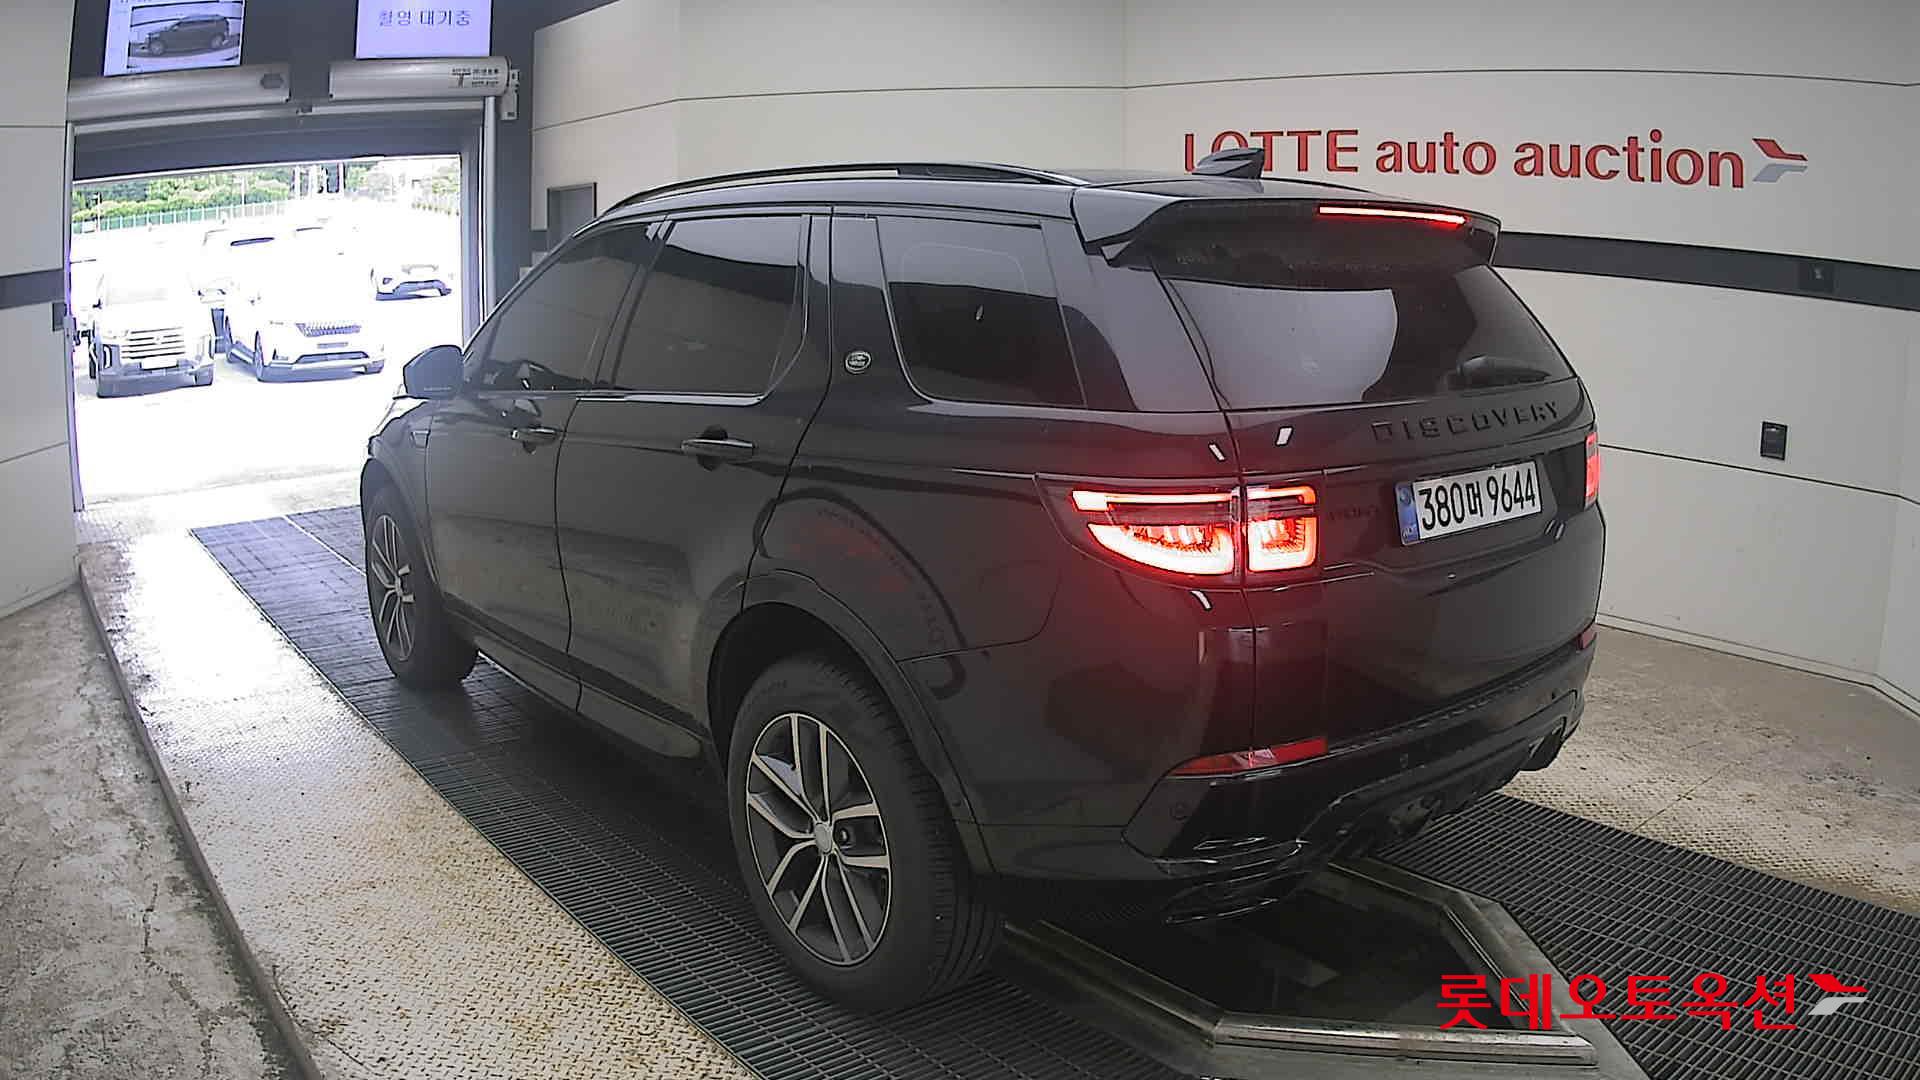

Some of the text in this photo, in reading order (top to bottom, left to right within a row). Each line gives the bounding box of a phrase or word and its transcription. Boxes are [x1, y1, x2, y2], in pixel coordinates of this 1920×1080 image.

[420, 9, 471, 26] 대기중
[1375, 131, 1497, 176] auto
[1512, 128, 1745, 189] auction
[1370, 399, 1559, 441] DISCOVERY
[1418, 468, 1536, 531] 380머 9644
